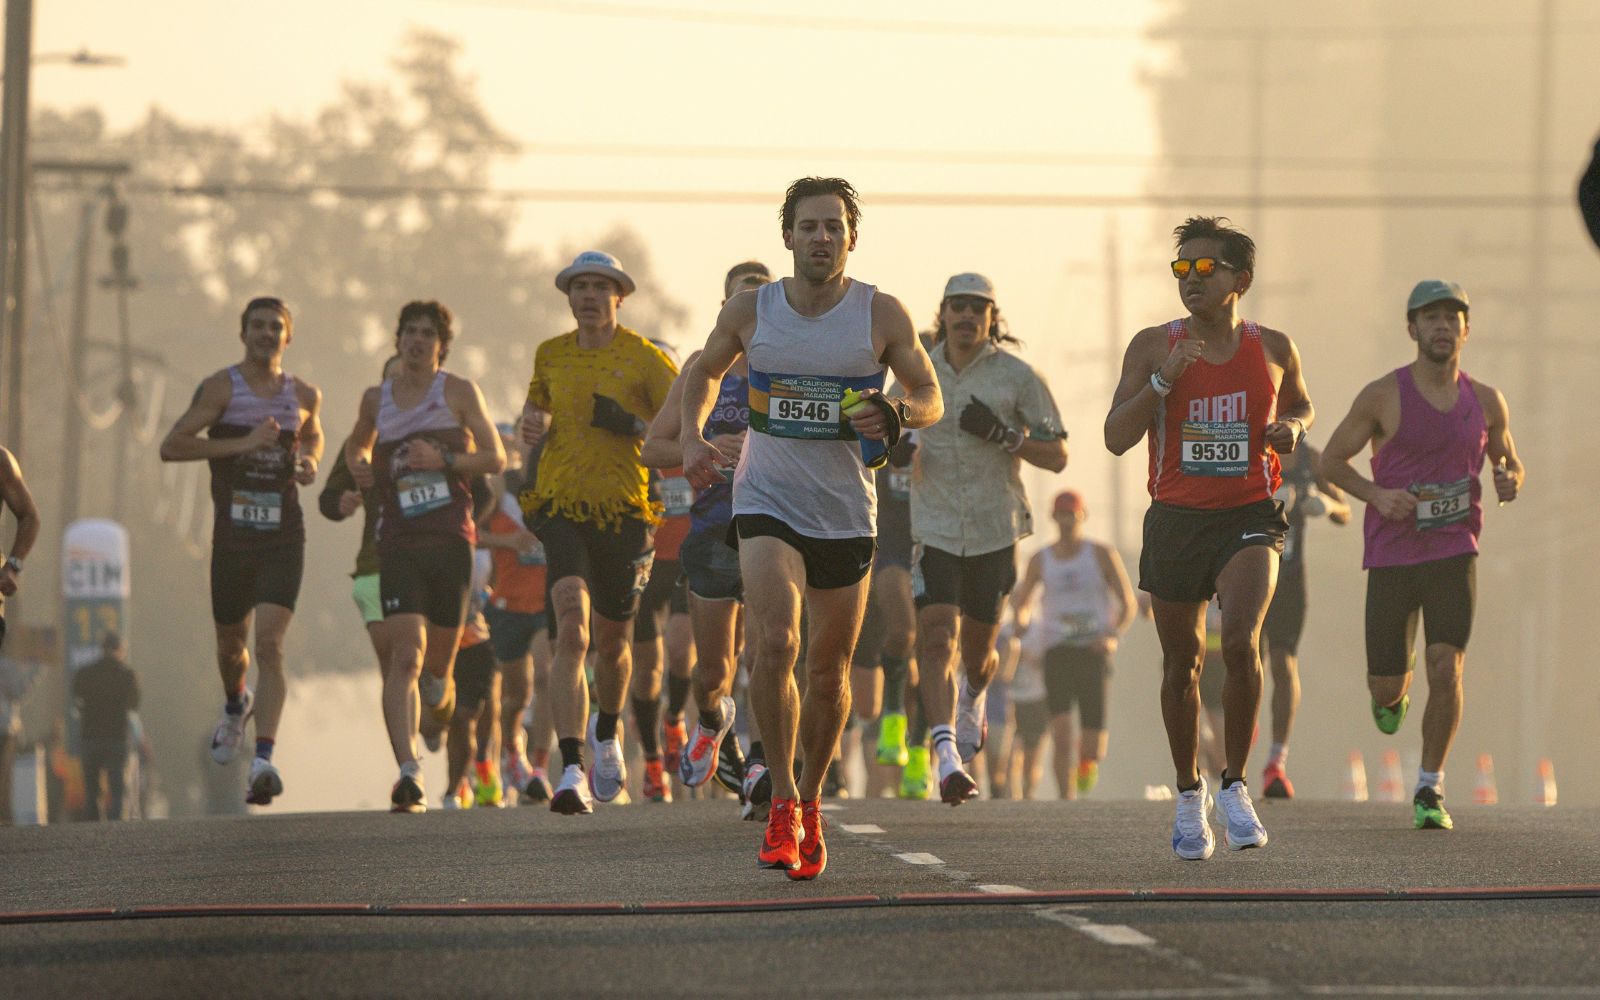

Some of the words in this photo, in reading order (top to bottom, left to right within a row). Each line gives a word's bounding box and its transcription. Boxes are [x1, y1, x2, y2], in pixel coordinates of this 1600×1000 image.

[778, 400, 830, 421] 9546
[1191, 443, 1240, 461] 9530
[410, 486, 436, 504] 612
[243, 506, 270, 521] 613
[1430, 498, 1460, 516] 623
